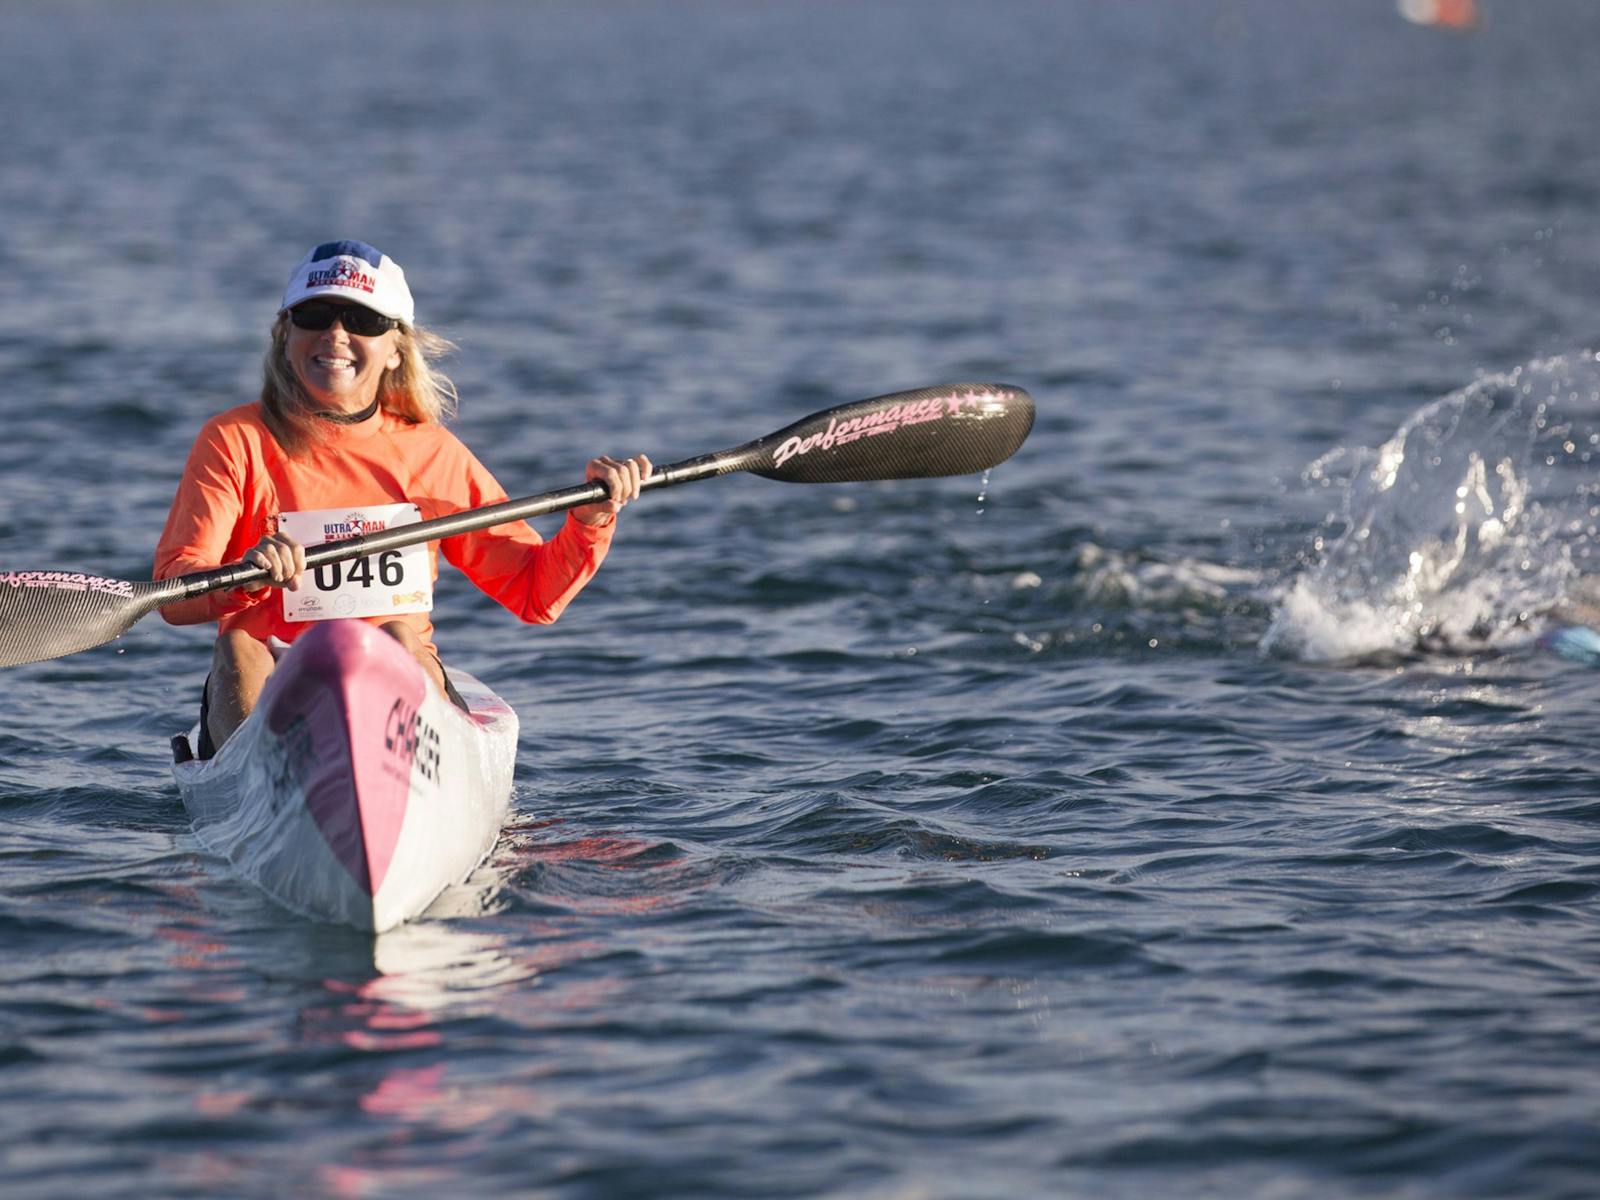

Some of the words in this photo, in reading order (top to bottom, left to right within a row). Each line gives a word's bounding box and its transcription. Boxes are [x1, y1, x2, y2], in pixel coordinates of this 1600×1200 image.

[773, 397, 943, 468] Performance
[324, 523, 353, 534] ULTRA
[362, 520, 386, 532] MAN
[314, 550, 404, 592] 046
